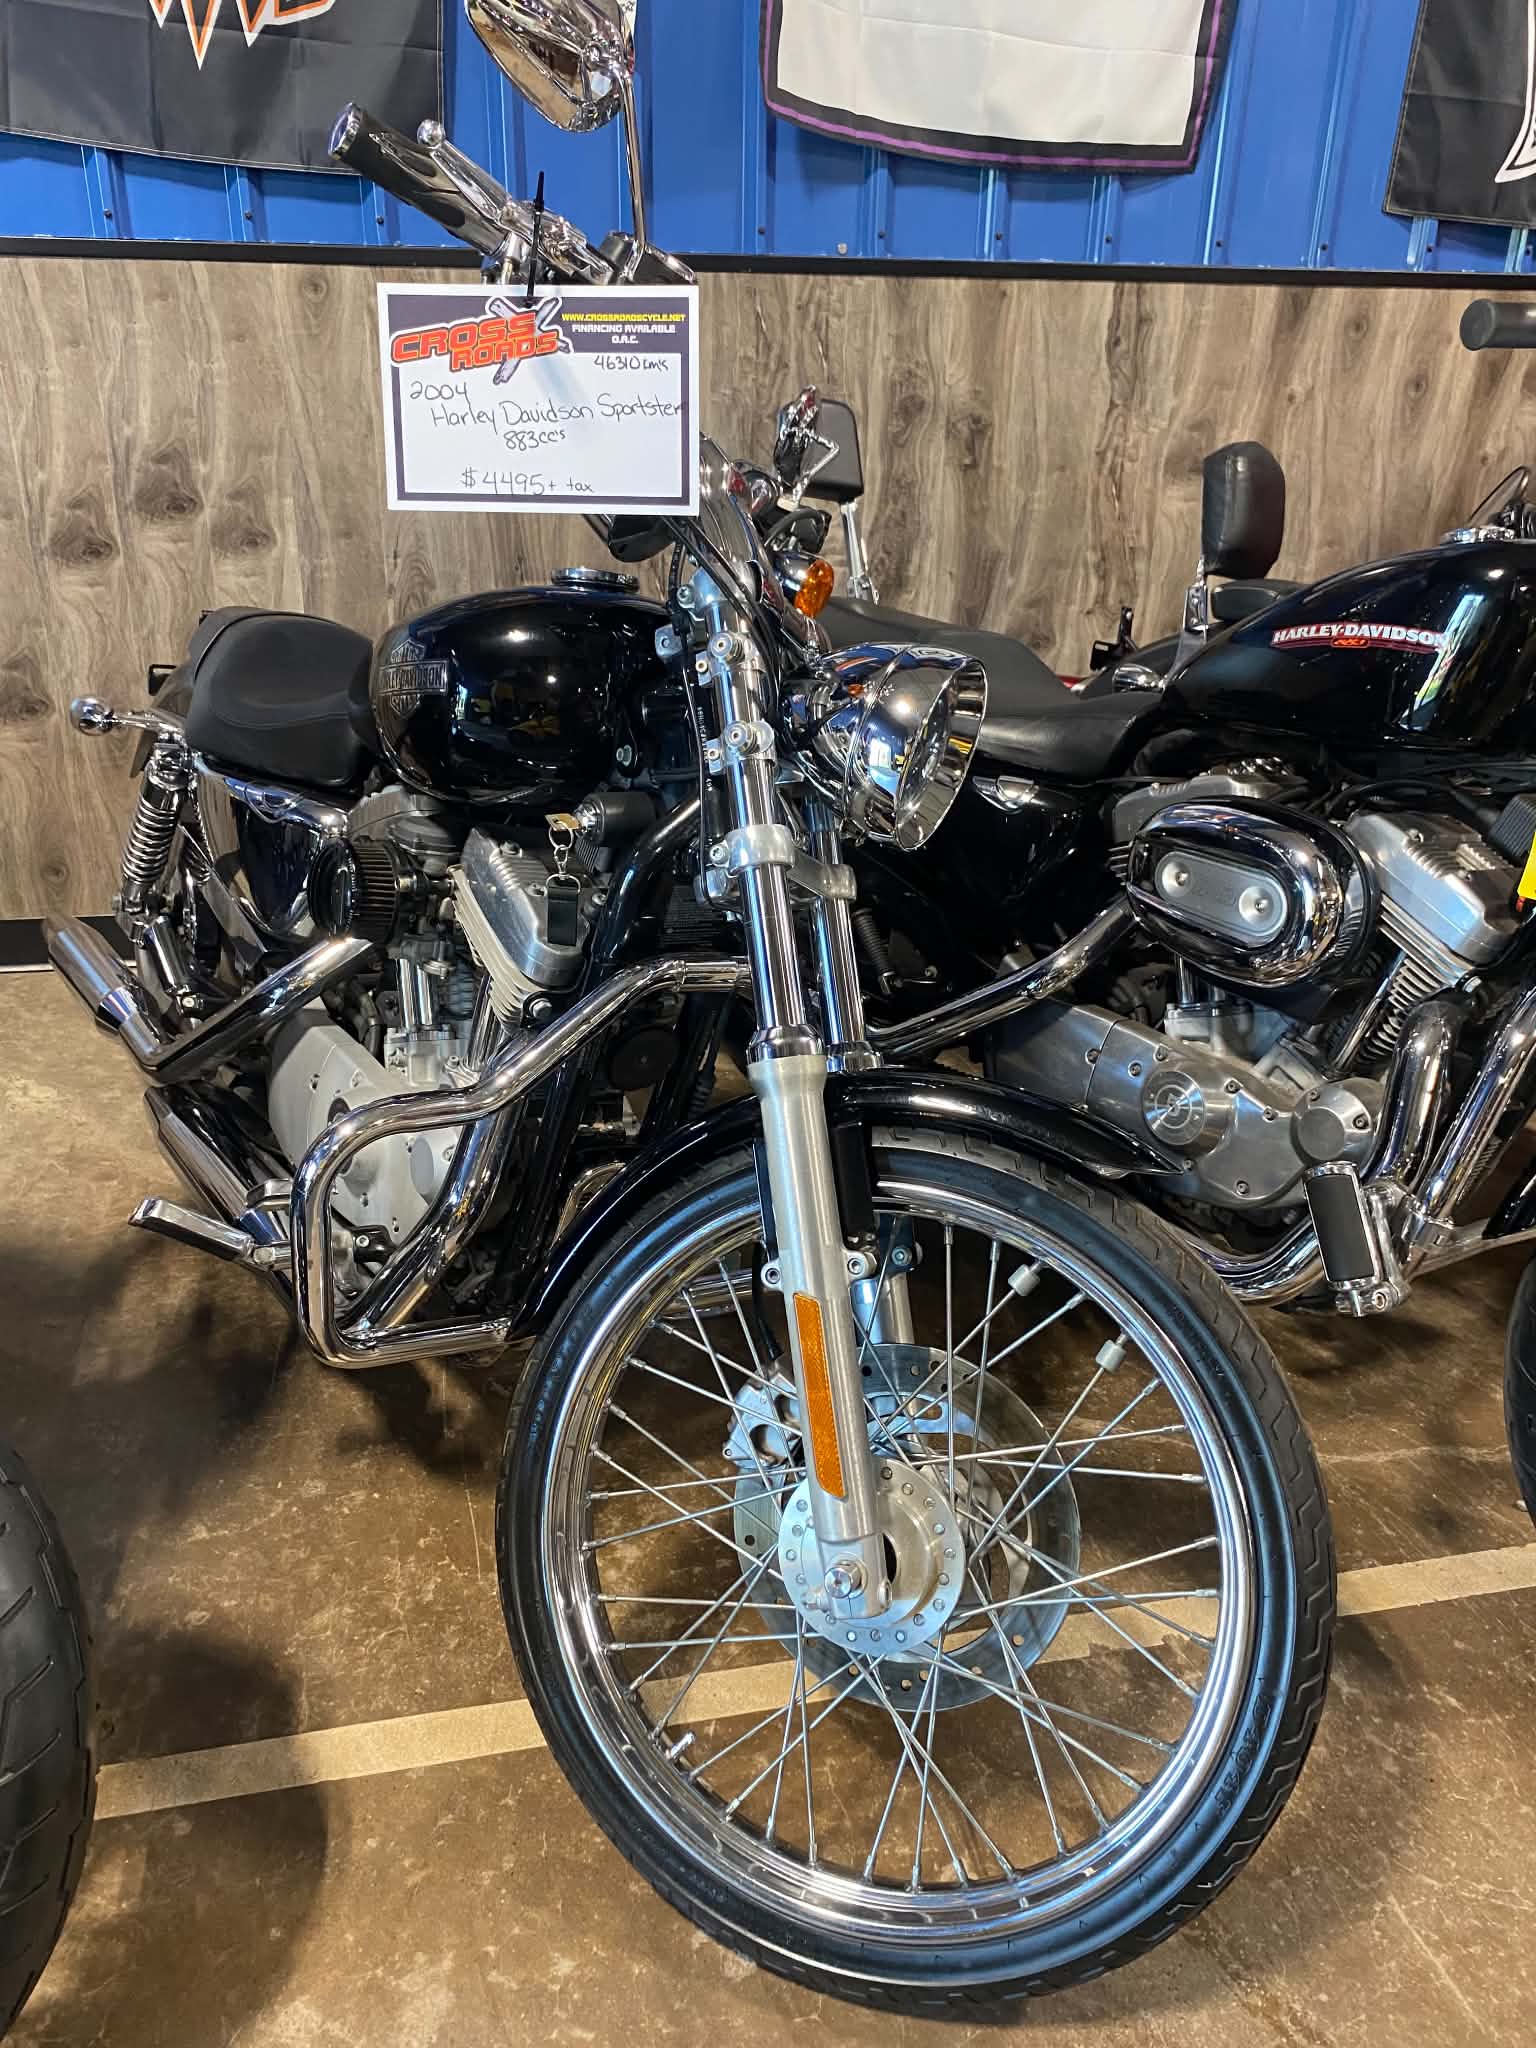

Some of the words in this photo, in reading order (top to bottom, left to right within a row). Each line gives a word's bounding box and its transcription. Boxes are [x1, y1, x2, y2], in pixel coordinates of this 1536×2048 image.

[393, 312, 536, 361] CROSS
[572, 324, 622, 332] FINANCING
[624, 324, 676, 333] AVAILABLE
[611, 335, 639, 343] O.A.C.
[451, 331, 558, 370] ROADS
[594, 355, 640, 370] 46310
[410, 381, 471, 400] 2004
[431, 399, 497, 435] Harley
[499, 399, 594, 426] Davidson
[597, 393, 683, 421] Sportster
[566, 476, 595, 493] tax
